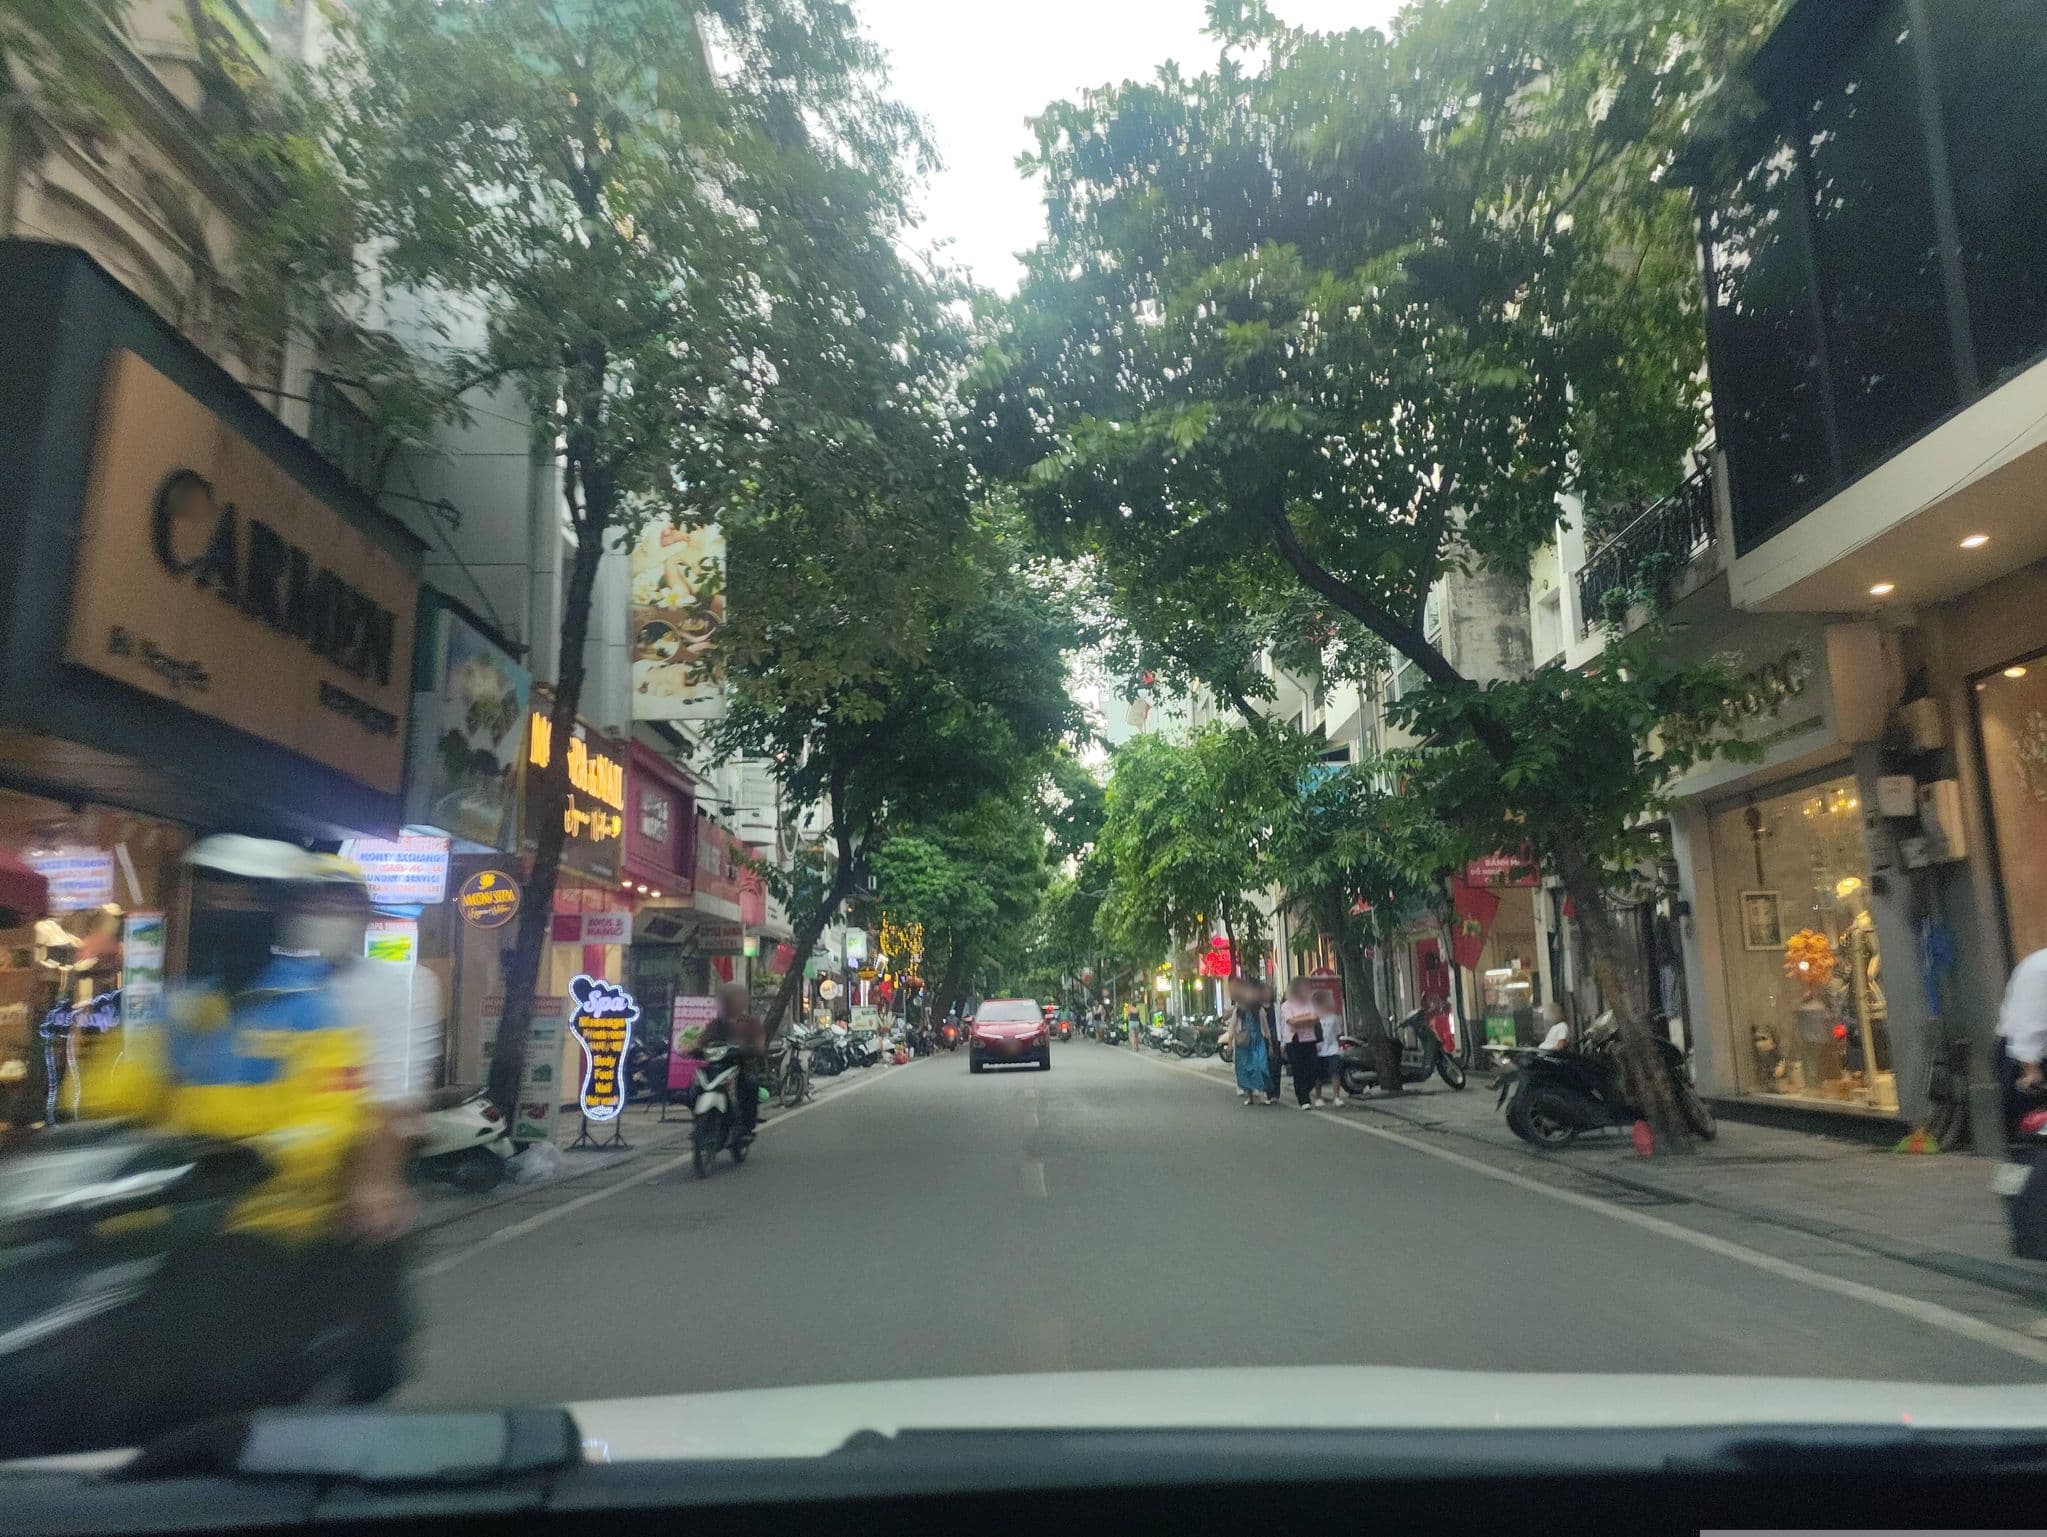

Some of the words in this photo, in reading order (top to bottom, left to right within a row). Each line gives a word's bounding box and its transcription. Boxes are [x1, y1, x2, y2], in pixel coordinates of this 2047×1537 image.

[583, 990, 627, 1018] Spa
[594, 1055, 617, 1068] Body
[594, 1069, 615, 1080] Foot
